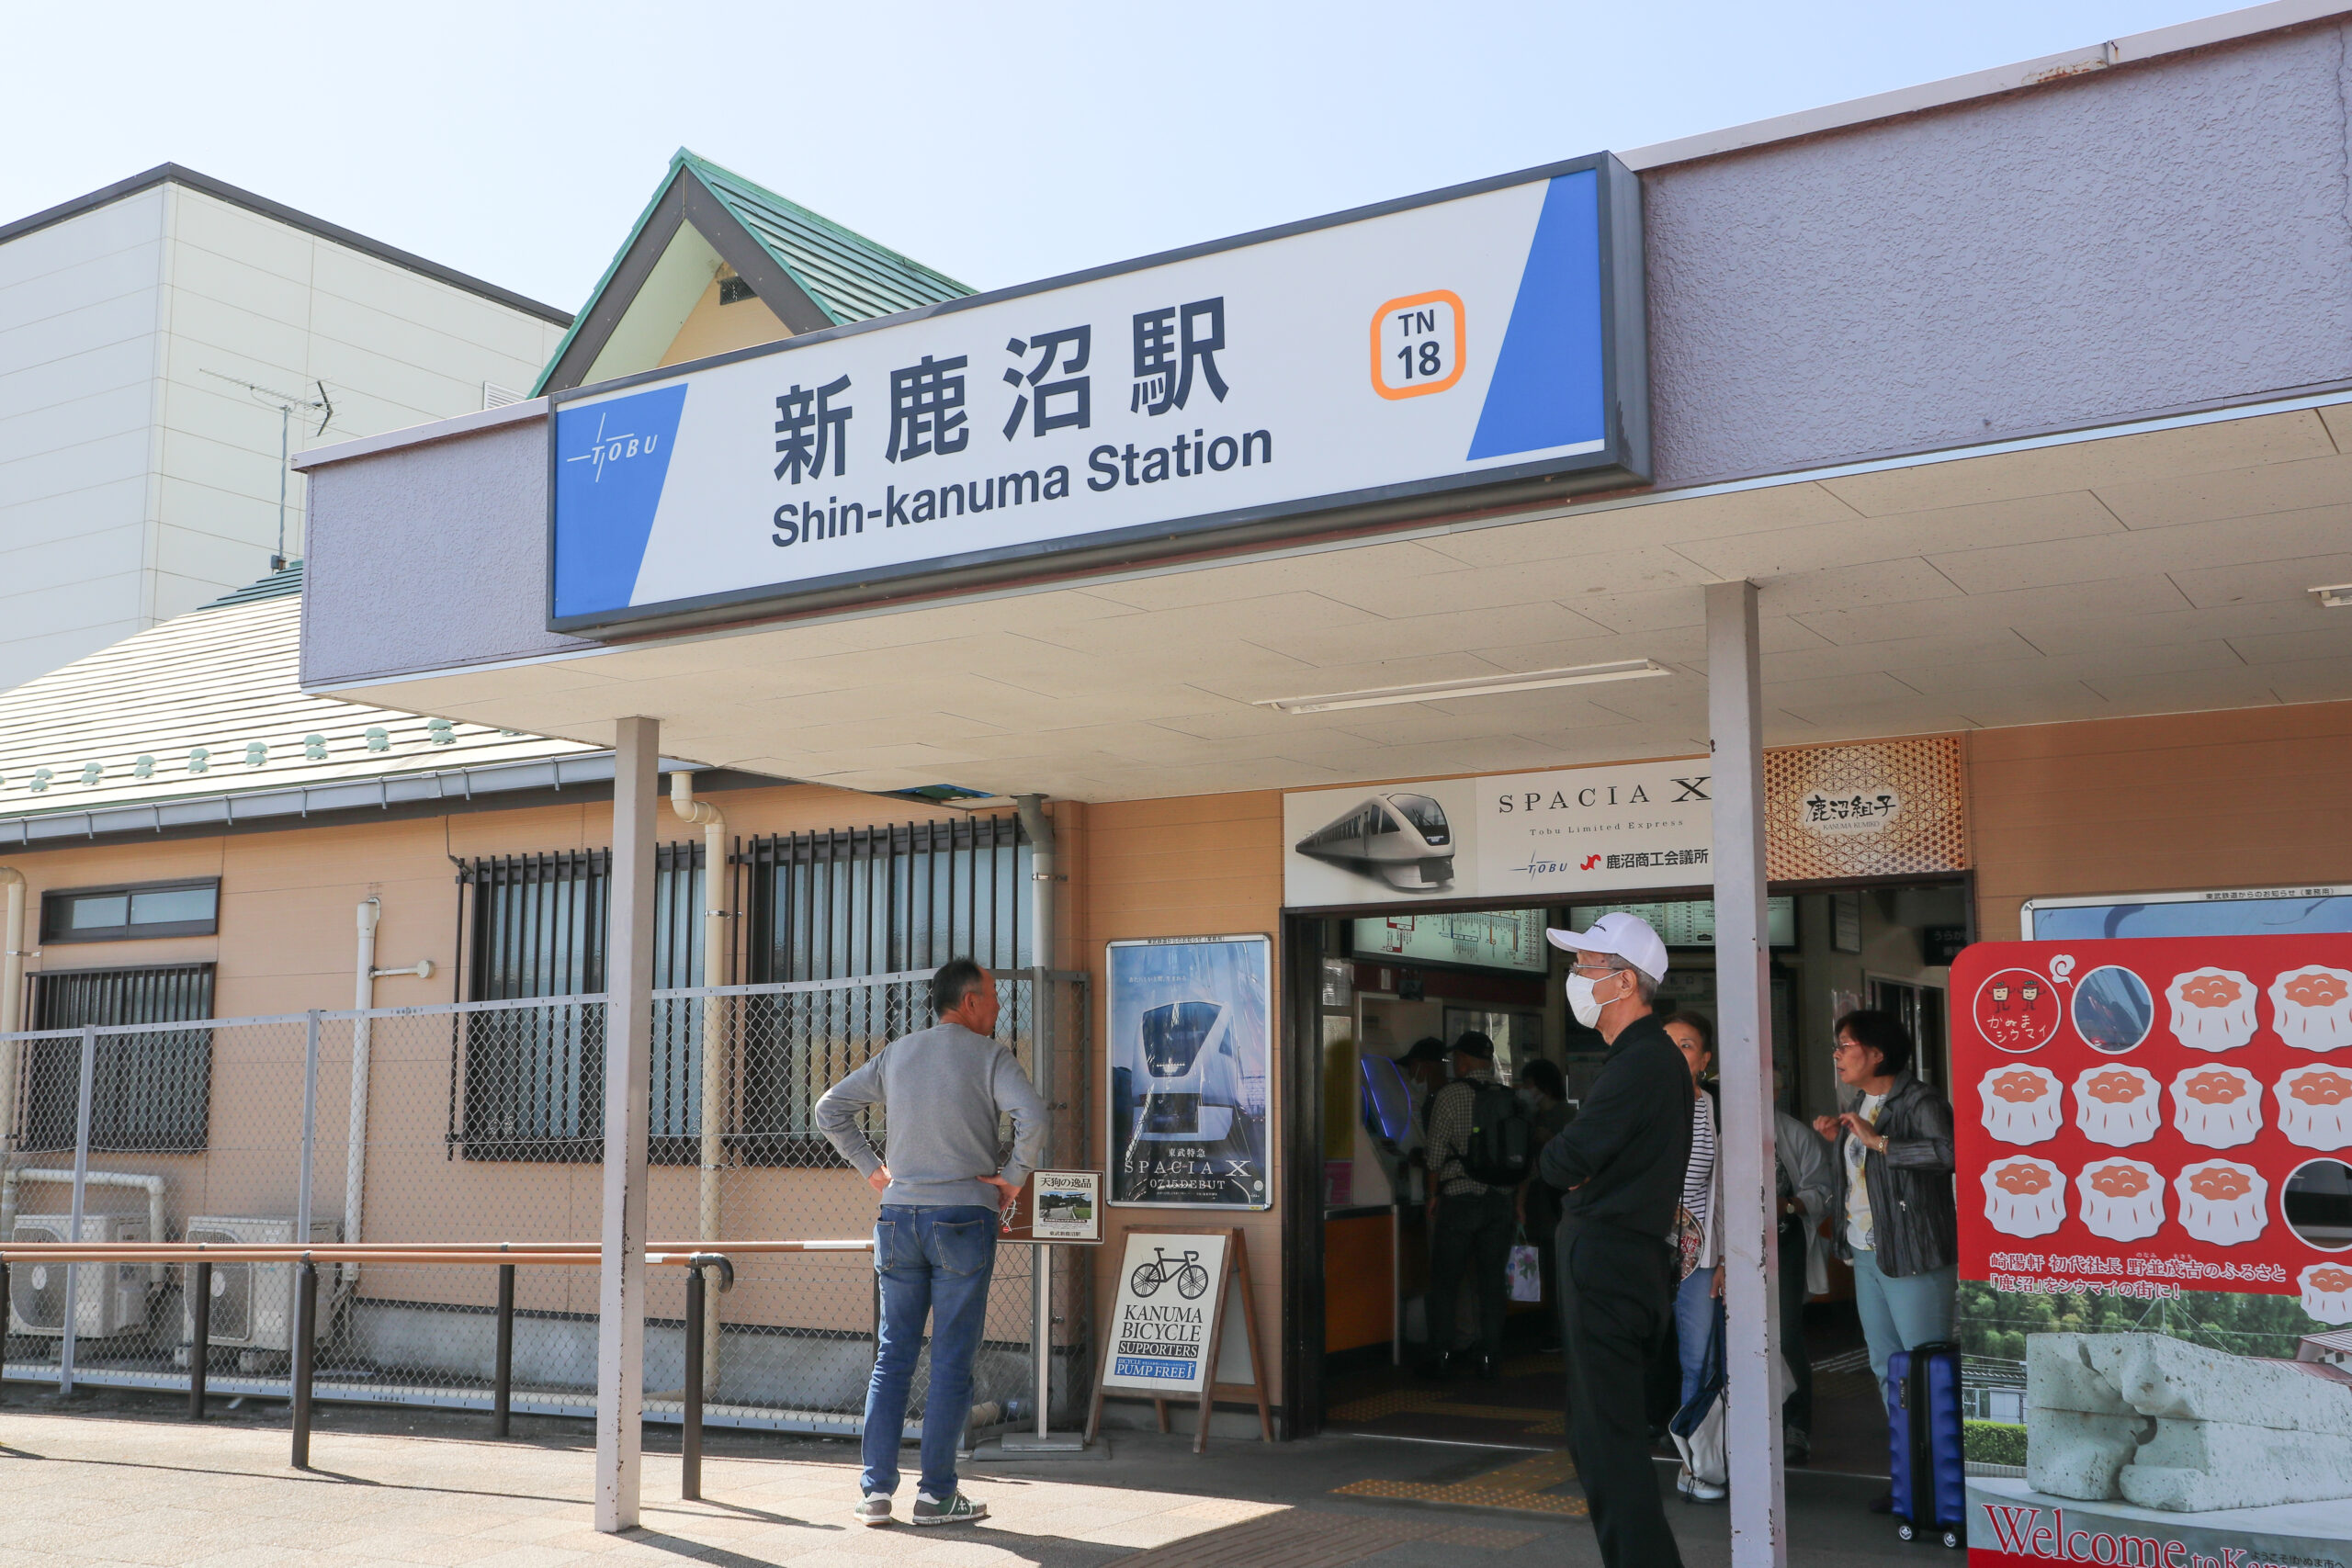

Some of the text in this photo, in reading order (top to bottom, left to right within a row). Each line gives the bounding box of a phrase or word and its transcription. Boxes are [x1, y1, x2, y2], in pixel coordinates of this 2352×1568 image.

[1397, 309, 1435, 337] TN
[1397, 341, 1442, 379] 18
[774, 296, 1229, 485] 新鹿沼駅
[592, 434, 659, 465] TOBU
[772, 428, 1272, 547] Shin-kanuma Station
[1498, 776, 1712, 814] SPACIA X
[1805, 795, 1896, 822] 鹿沼組子
[1529, 819, 1684, 836] Tobu Limited Express
[1528, 863, 1568, 874] TOBU
[1606, 849, 1709, 870] 鹿沼商工会議所
[1986, 1014, 2030, 1029] かぬま
[1996, 1024, 2046, 1043] シウマイ
[1168, 1148, 1205, 1158] 東武特急
[1124, 1159, 1252, 1178] SPACIA X
[1039, 1177, 1091, 1189] 天狗の逸品
[1989, 1252, 2287, 1283] 崎陽軒 初代社長 野並茂吉のふるさと
[1124, 1305, 1203, 1323] KANUMA
[1121, 1322, 1202, 1341] BICYCLE
[1119, 1341, 1197, 1357] SUPPORTERS
[1116, 1364, 1186, 1379] PUMP FREE
[1982, 1504, 2187, 1568] Welcome
